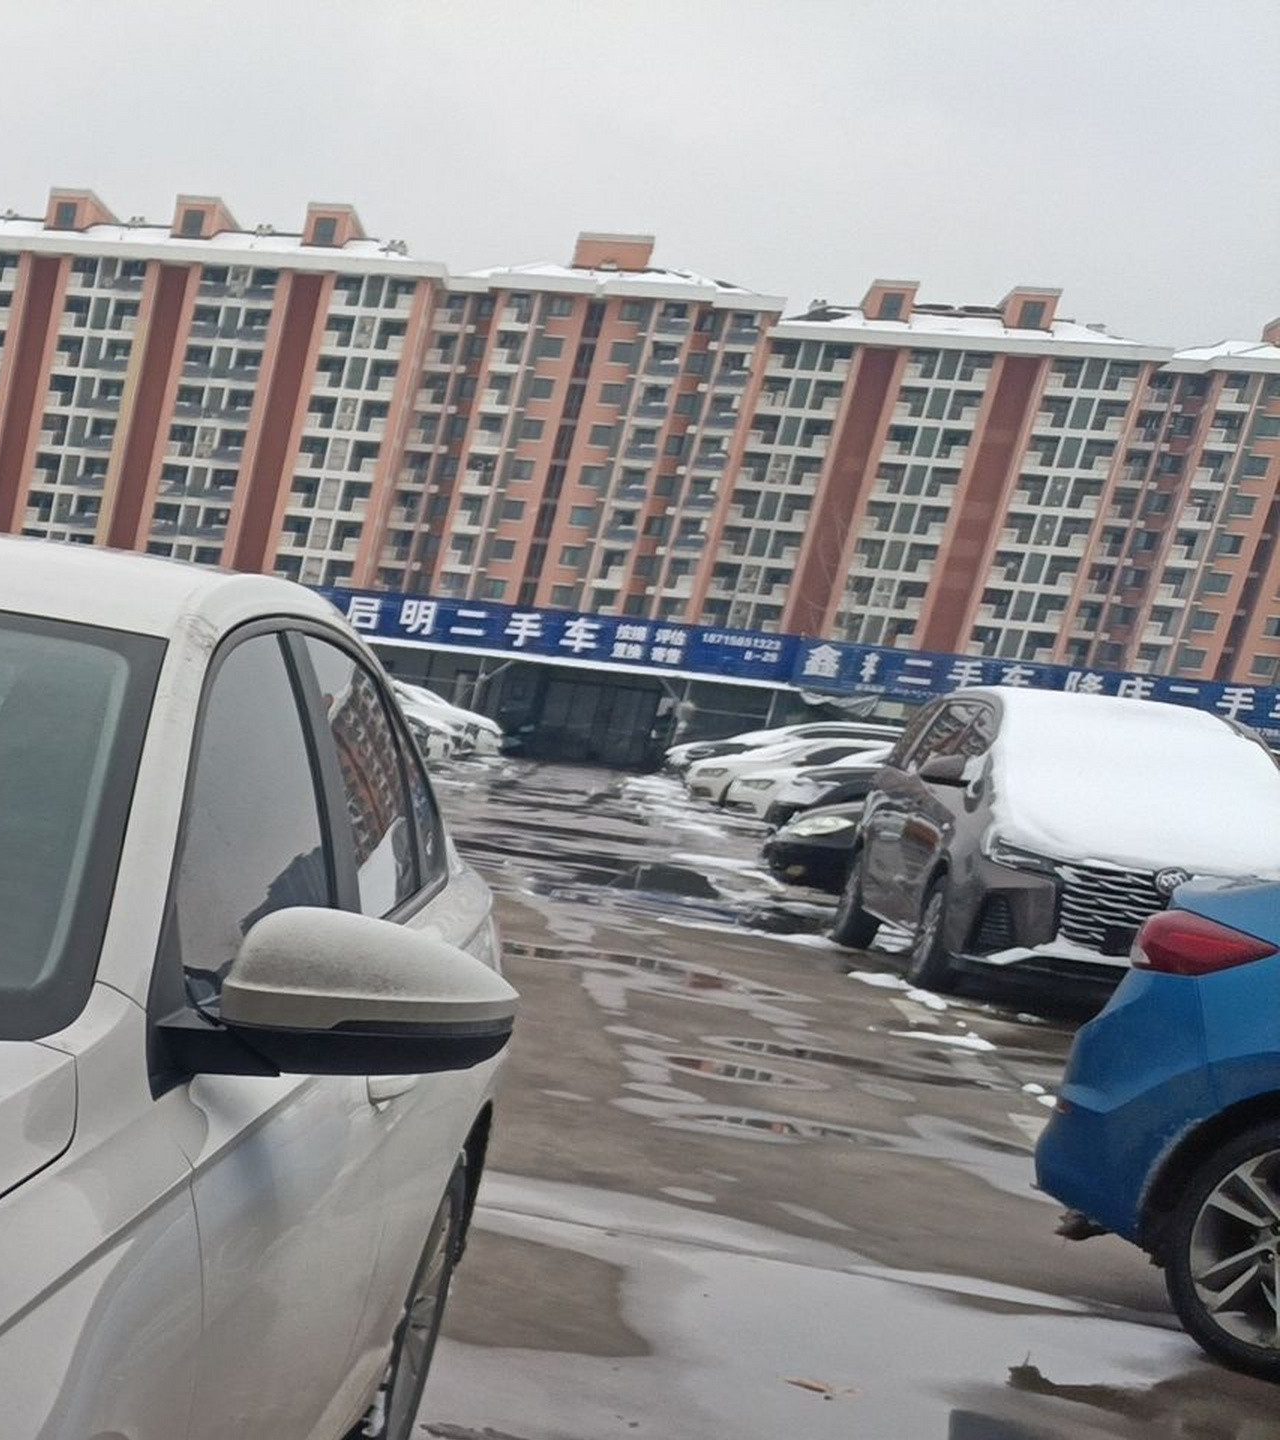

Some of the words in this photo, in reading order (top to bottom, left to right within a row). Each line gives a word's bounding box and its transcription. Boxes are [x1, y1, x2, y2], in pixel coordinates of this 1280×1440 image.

[346, 596, 601, 653] 启明二手车
